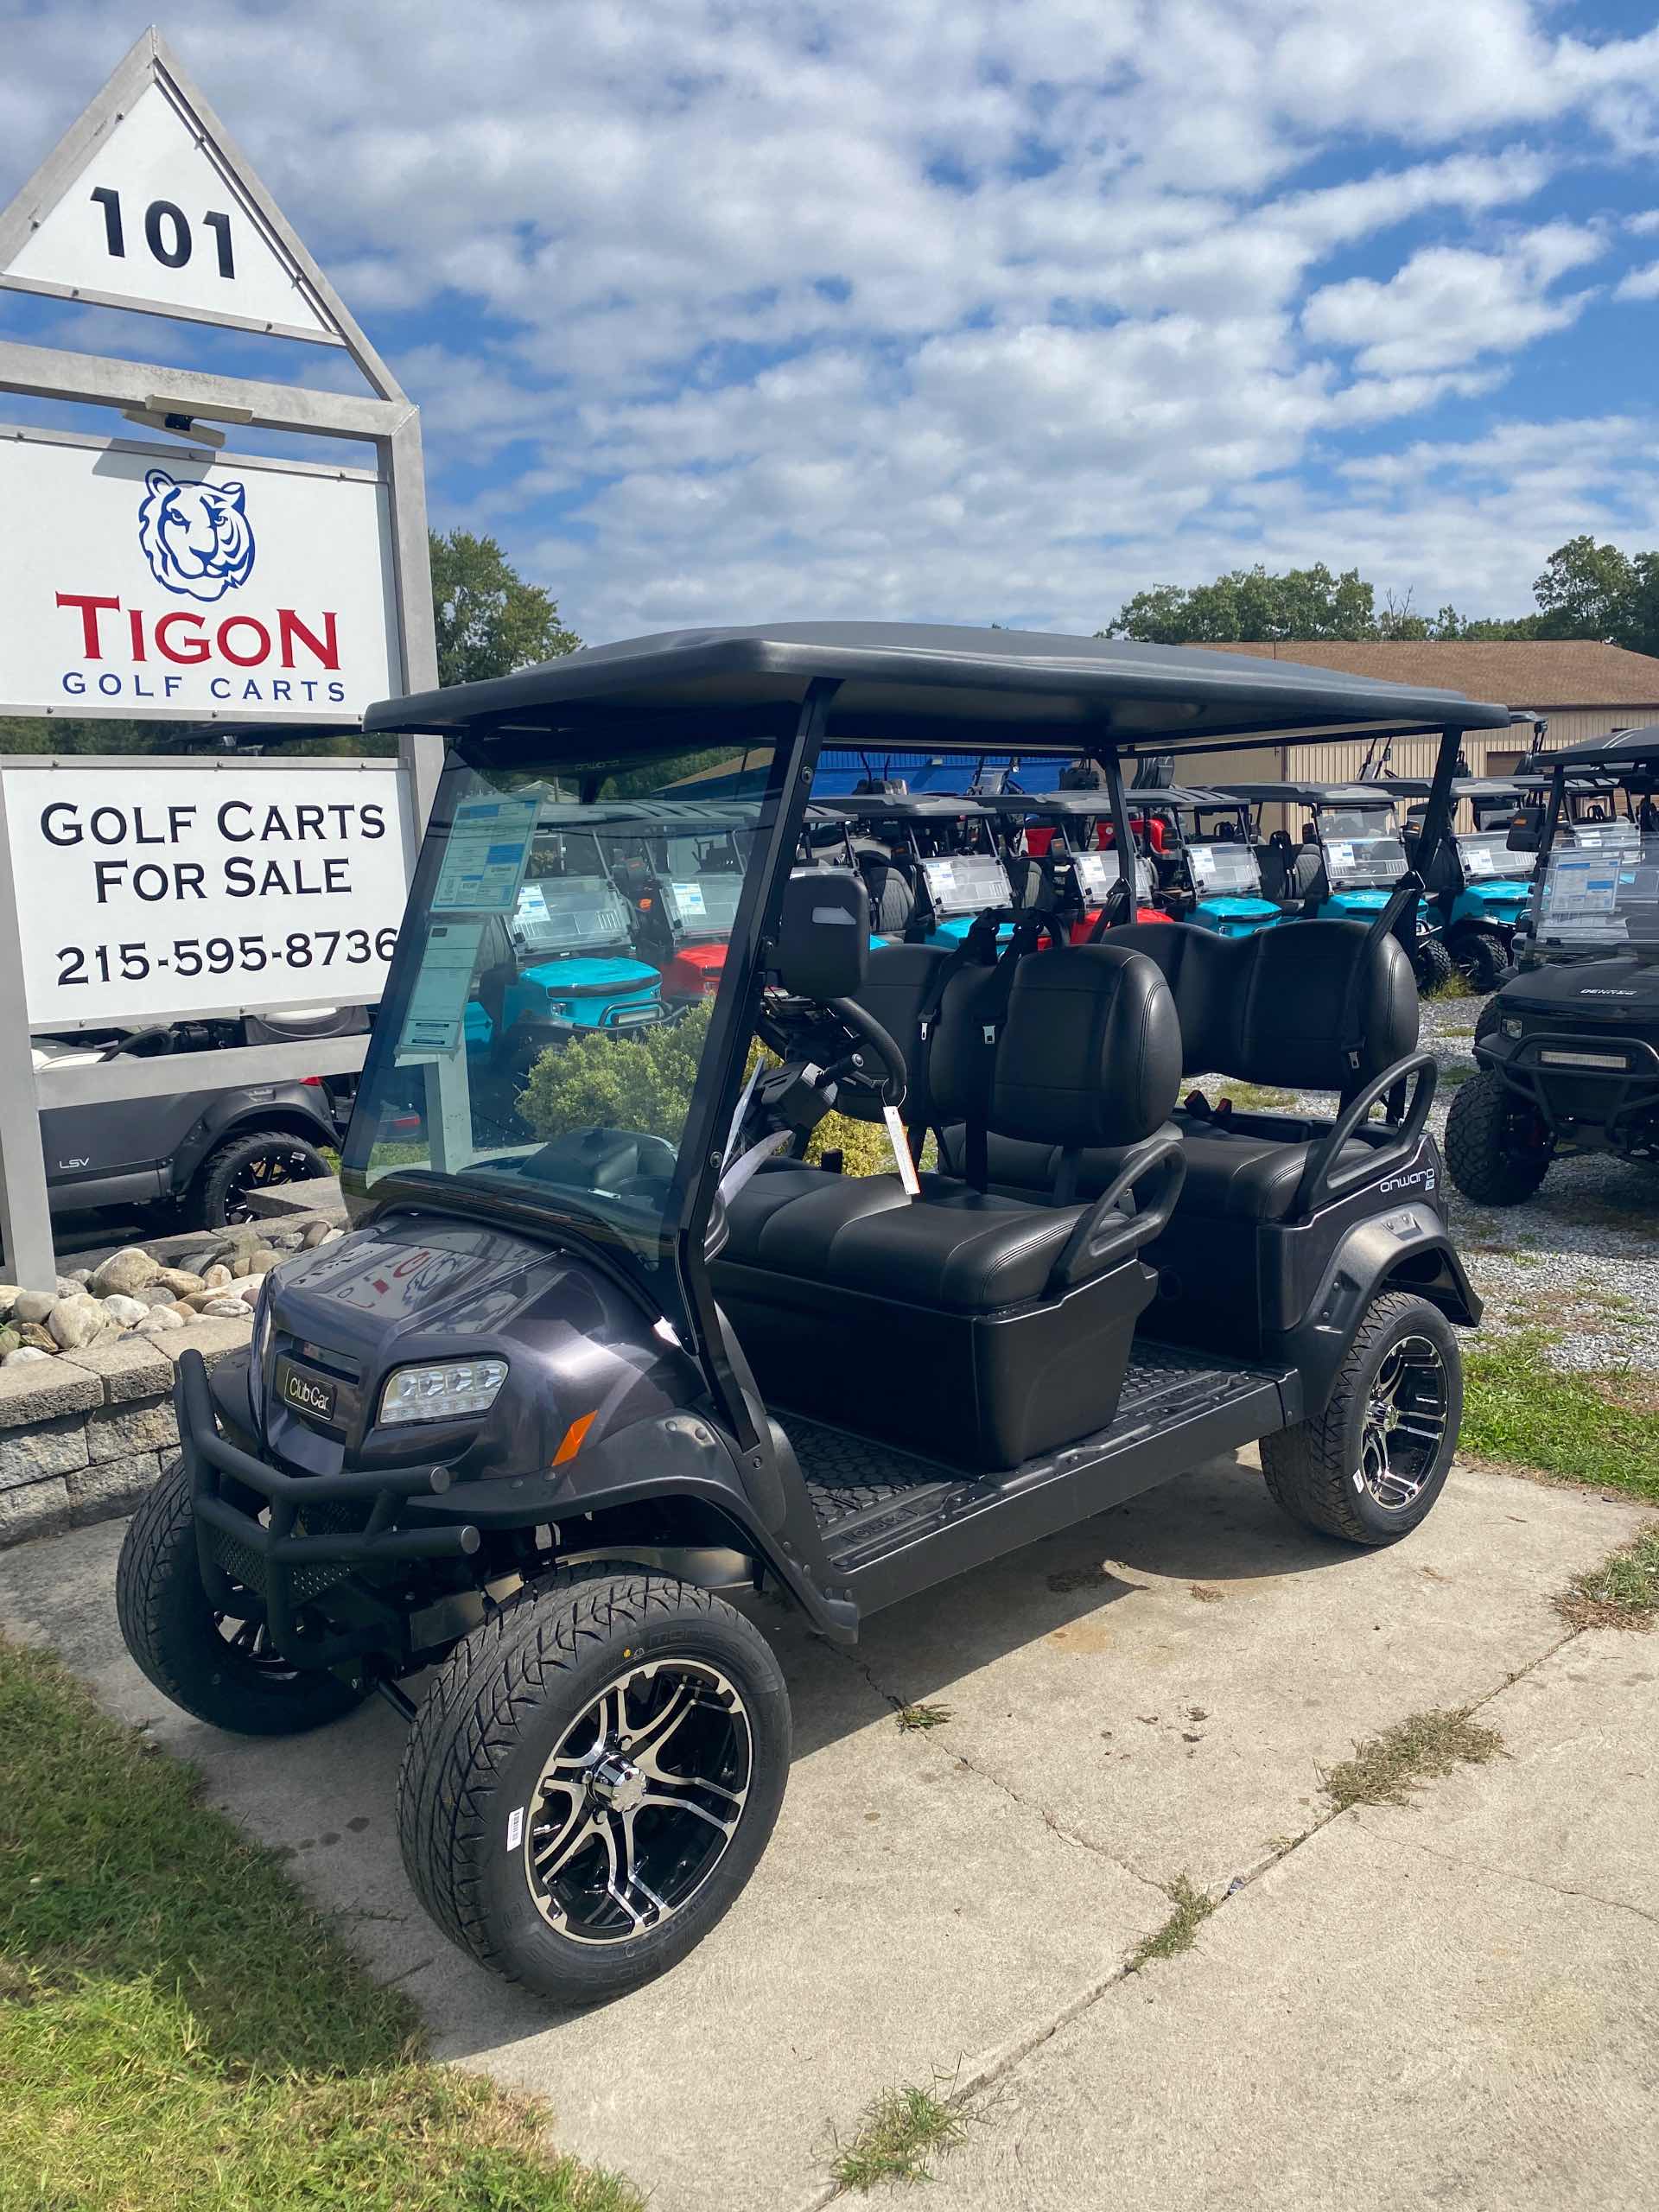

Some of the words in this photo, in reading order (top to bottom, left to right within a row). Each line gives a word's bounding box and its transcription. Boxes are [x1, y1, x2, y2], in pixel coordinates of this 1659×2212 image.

[90, 186, 235, 280] 101
[55, 591, 341, 671] TIGON
[62, 671, 182, 697] GOLF
[210, 677, 345, 702] CARTS
[40, 802, 197, 847] GOLF
[217, 800, 385, 842] CARTS
[92, 859, 208, 904] FOR
[224, 856, 352, 898] SALE
[56, 927, 398, 987] 215-595-8736
[59, 1157, 90, 1169] LSV
[290, 1377, 309, 1402] Club
[311, 1387, 328, 1409] Car
